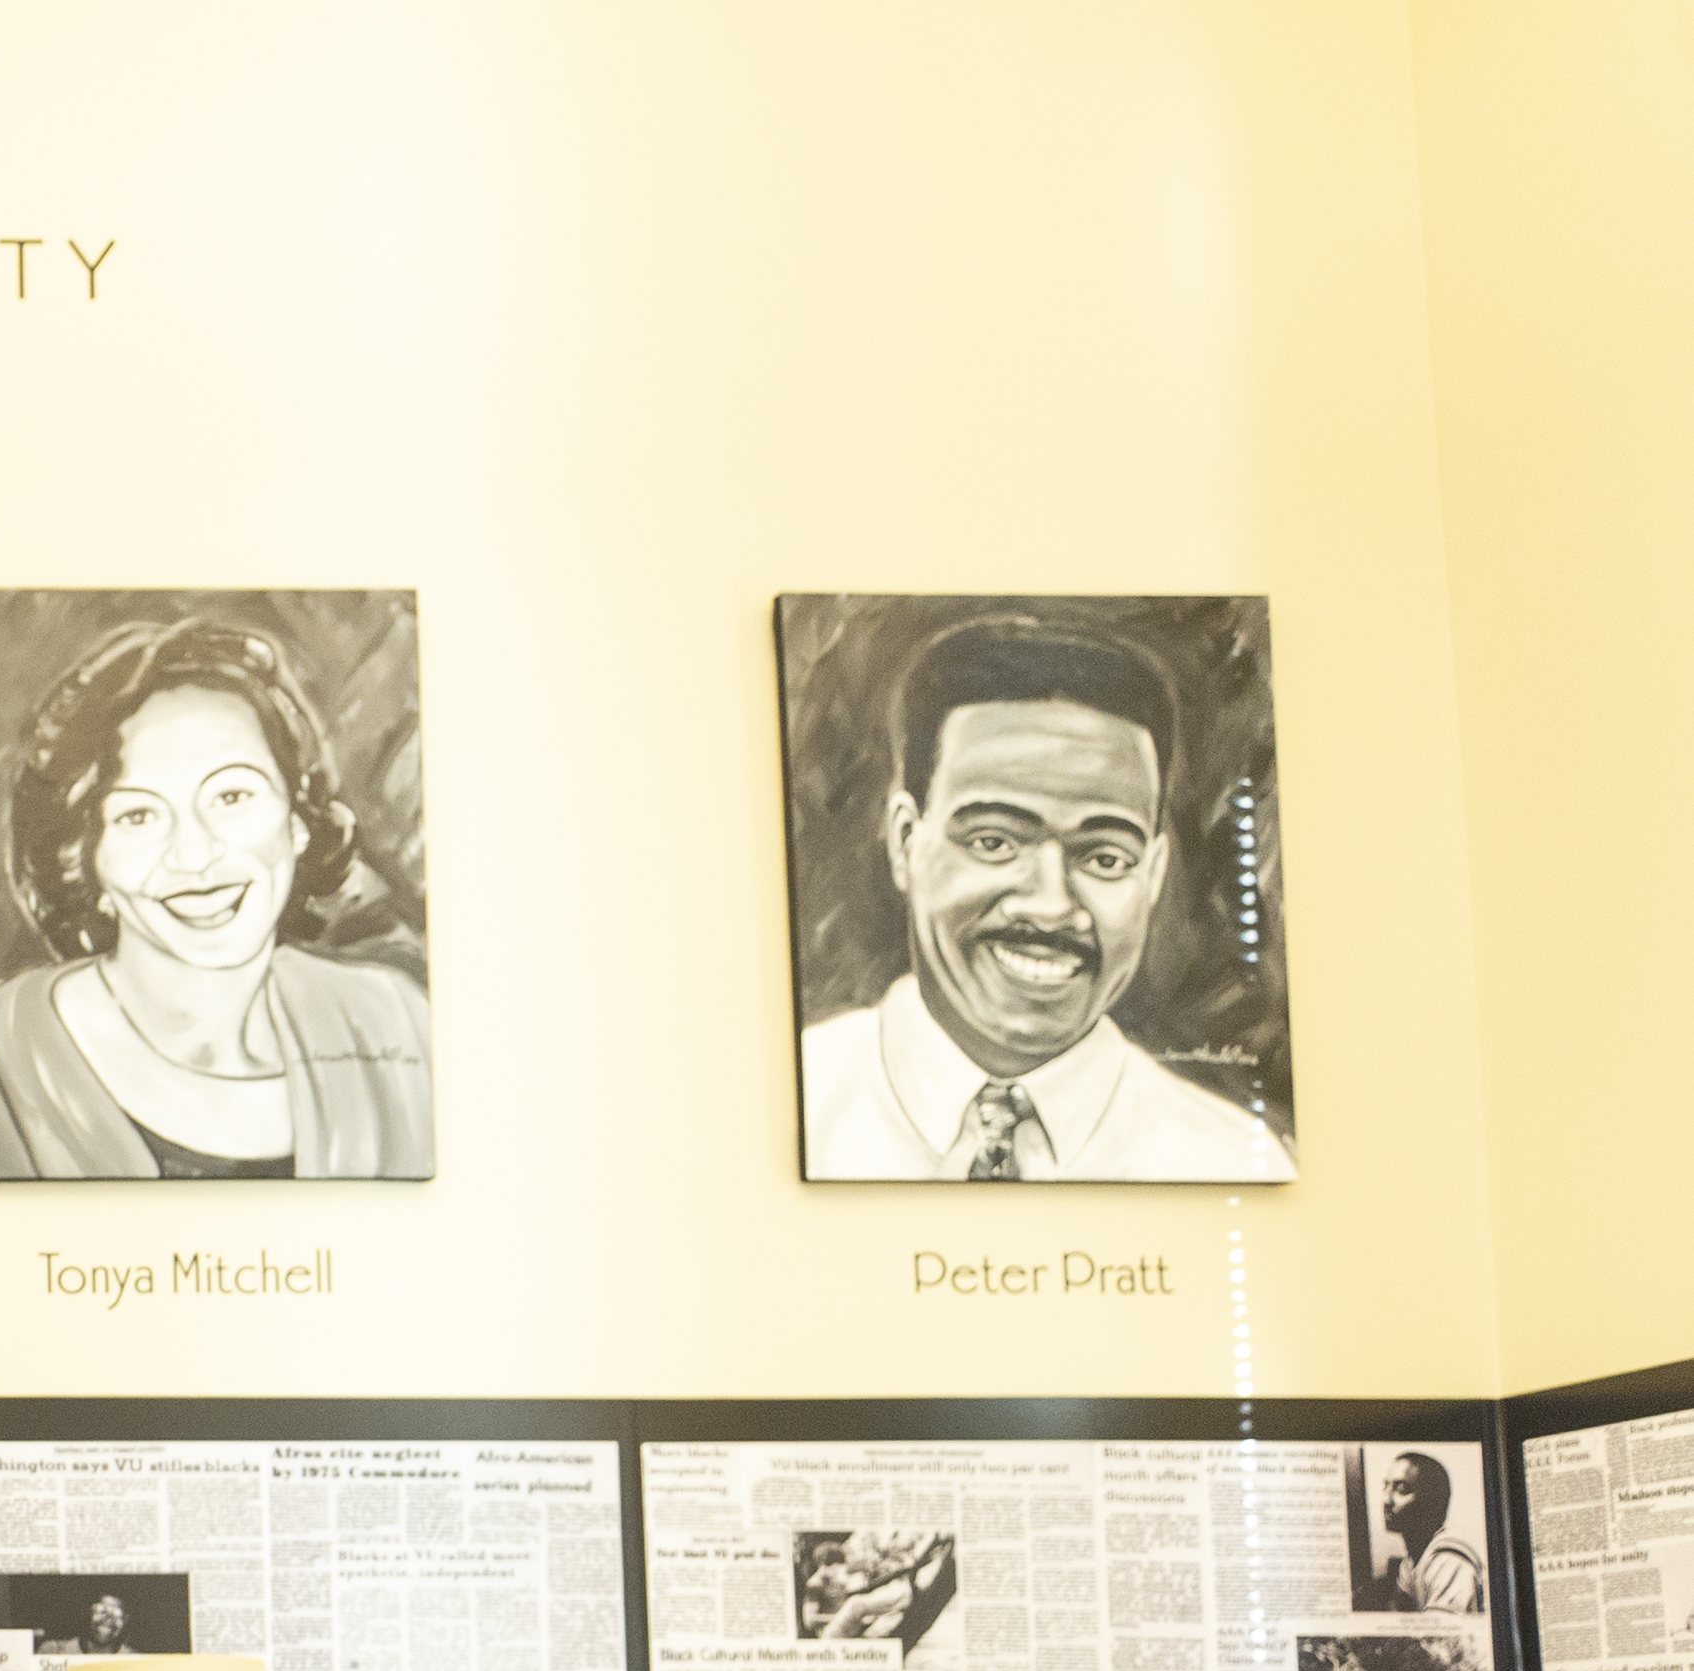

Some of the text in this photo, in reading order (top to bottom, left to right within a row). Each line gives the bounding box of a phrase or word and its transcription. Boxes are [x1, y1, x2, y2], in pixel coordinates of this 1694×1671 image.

[39, 1249, 331, 1310] Tonya Mitchell
[914, 1251, 1172, 1295] Peter Pratt
